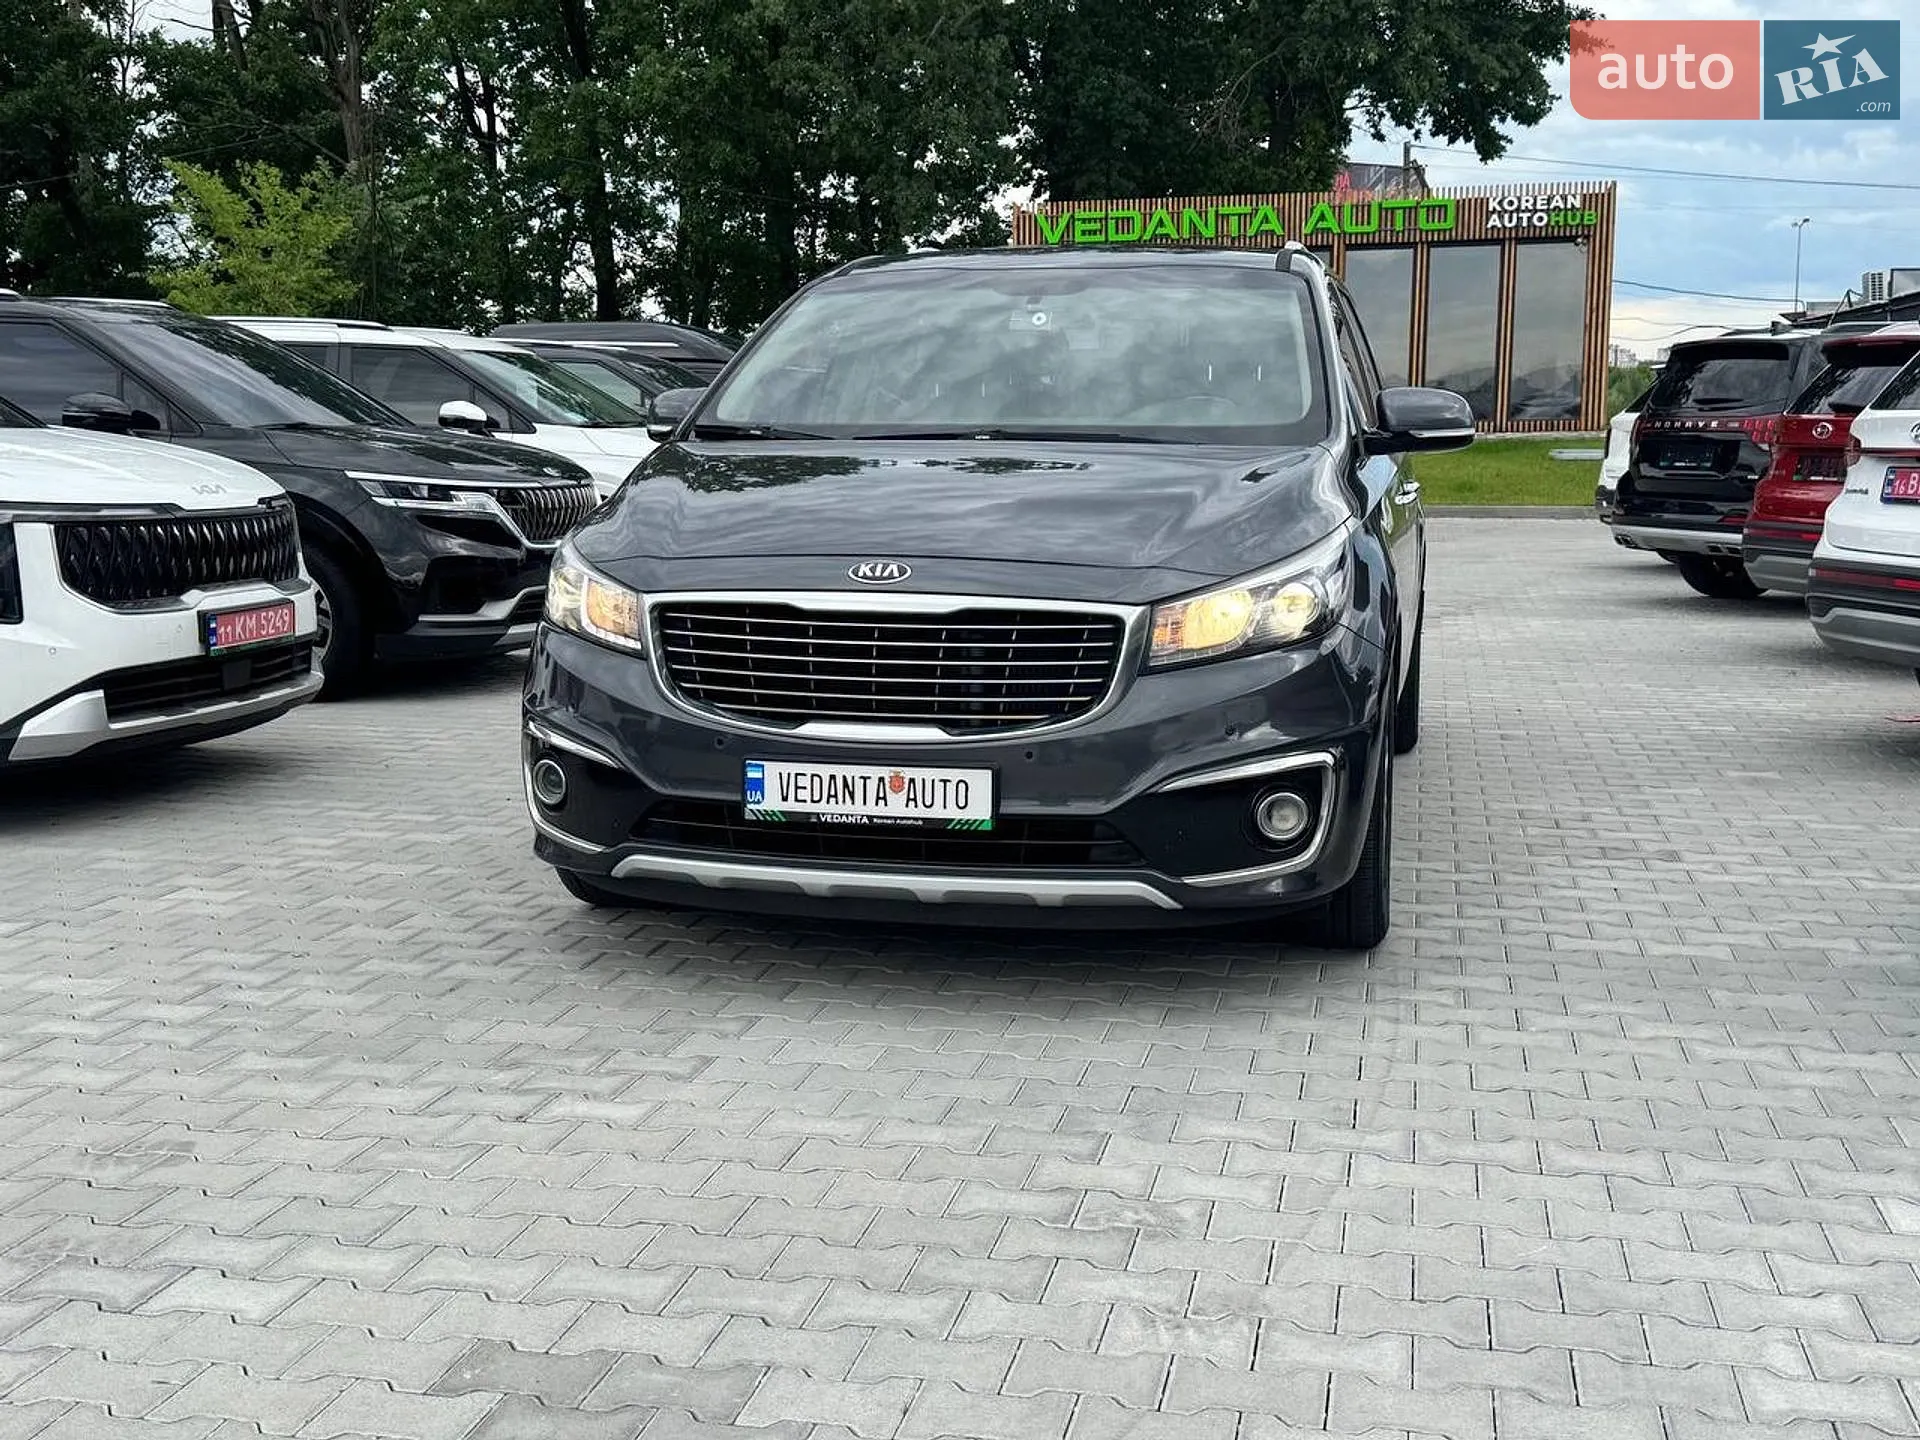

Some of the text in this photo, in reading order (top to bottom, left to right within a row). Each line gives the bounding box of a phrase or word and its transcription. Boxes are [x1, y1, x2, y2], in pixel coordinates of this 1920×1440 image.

[1488, 194, 1581, 212] KOREAN
[1034, 198, 1457, 244] VEDANTA AUTO
[1486, 210, 1598, 229] AUTOHUB
[858, 563, 900, 577] KIA
[235, 613, 257, 641] KM
[260, 608, 290, 635] 5249
[746, 790, 763, 802] UA
[778, 771, 969, 810] VEDANTA AUTO
[819, 814, 870, 825] VEDANTA
